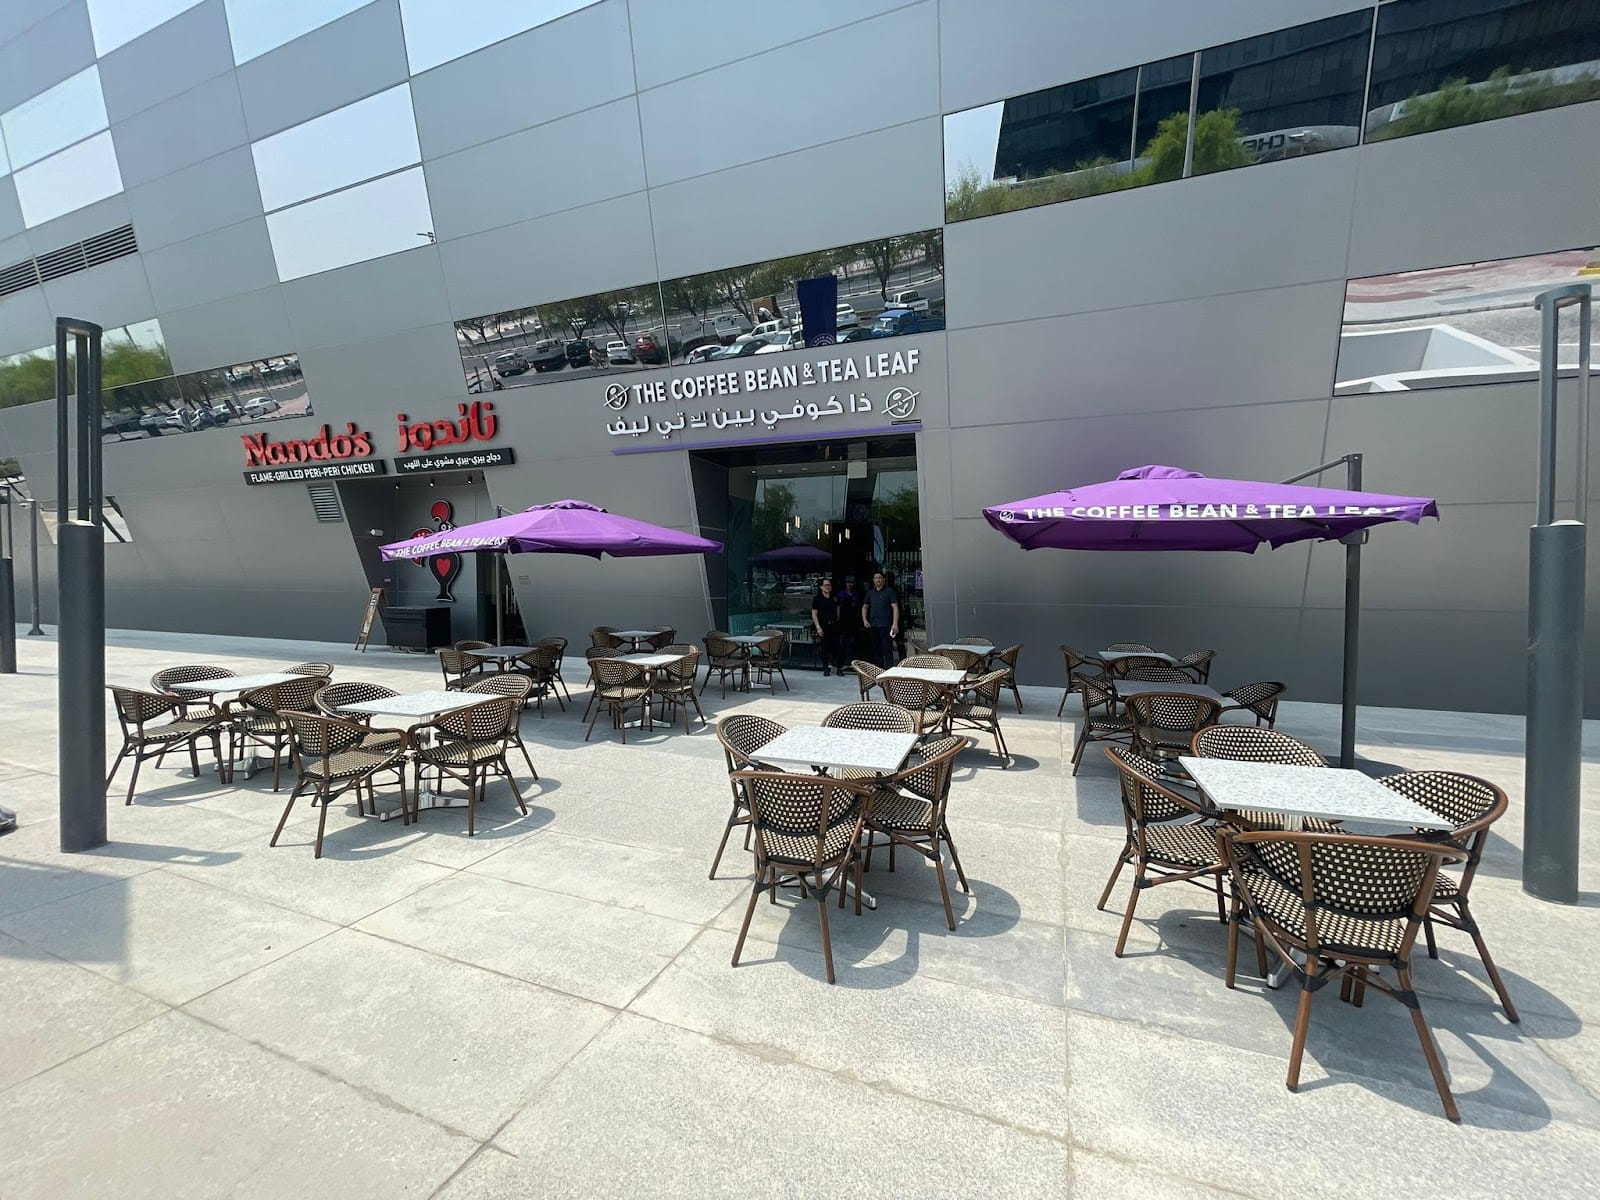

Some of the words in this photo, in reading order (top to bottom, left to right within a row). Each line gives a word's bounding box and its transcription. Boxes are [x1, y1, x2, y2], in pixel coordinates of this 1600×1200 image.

[632, 379, 667, 404] THE
[670, 371, 740, 400] COFFEE
[745, 364, 798, 392] BEAN
[802, 361, 817, 385] &
[817, 356, 860, 383] TEA
[865, 348, 920, 379] LEAF
[711, 401, 757, 430] بين
[760, 394, 844, 430] كوفي
[849, 391, 873, 414] ذا
[396, 400, 499, 453] ناندوز
[606, 414, 651, 438] ليف
[655, 411, 686, 440] تي
[241, 421, 374, 467] Nando's
[250, 469, 304, 483] FLAME-GRILLED
[340, 462, 375, 476] CHICKEN
[1023, 507, 1065, 520] THE
[1072, 504, 1160, 519] COFFEE
[1169, 503, 1237, 518] BEAN
[1243, 503, 1262, 519] &
[1265, 504, 1317, 519] TEA
[395, 546, 410, 558] THE
[411, 541, 440, 556] COFFEE
[440, 537, 463, 549] BEAN
